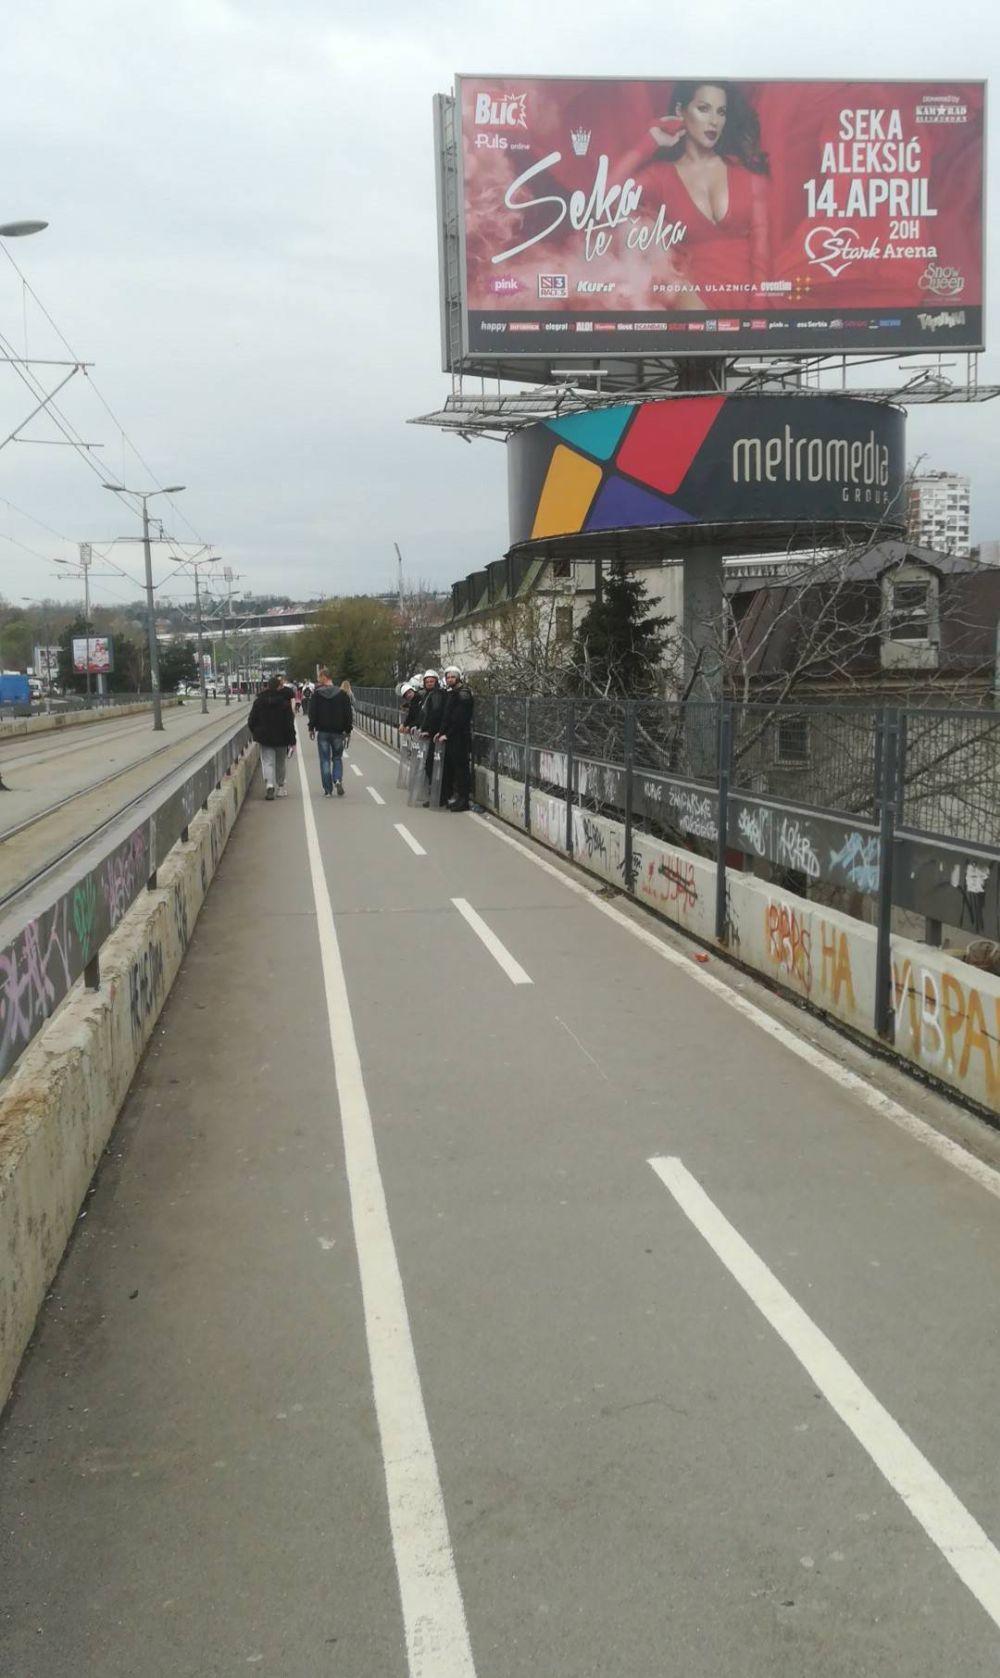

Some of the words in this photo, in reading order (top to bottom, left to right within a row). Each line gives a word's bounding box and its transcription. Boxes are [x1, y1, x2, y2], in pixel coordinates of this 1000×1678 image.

[839, 109, 903, 140] SEKA
[475, 134, 508, 149] Puls
[820, 136, 921, 173] ALEKSIĆ
[491, 151, 642, 264] Seka
[804, 178, 938, 218] 14.APRIL
[585, 217, 620, 262] te
[627, 204, 687, 250] čeka
[889, 220, 920, 240] 20H
[883, 243, 938, 259] Arena
[495, 278, 518, 291] pink
[653, 284, 700, 292] PRODAJA
[705, 284, 757, 292] ULAZNICA
[481, 321, 507, 331] happy
[732, 424, 889, 486] metromedia
